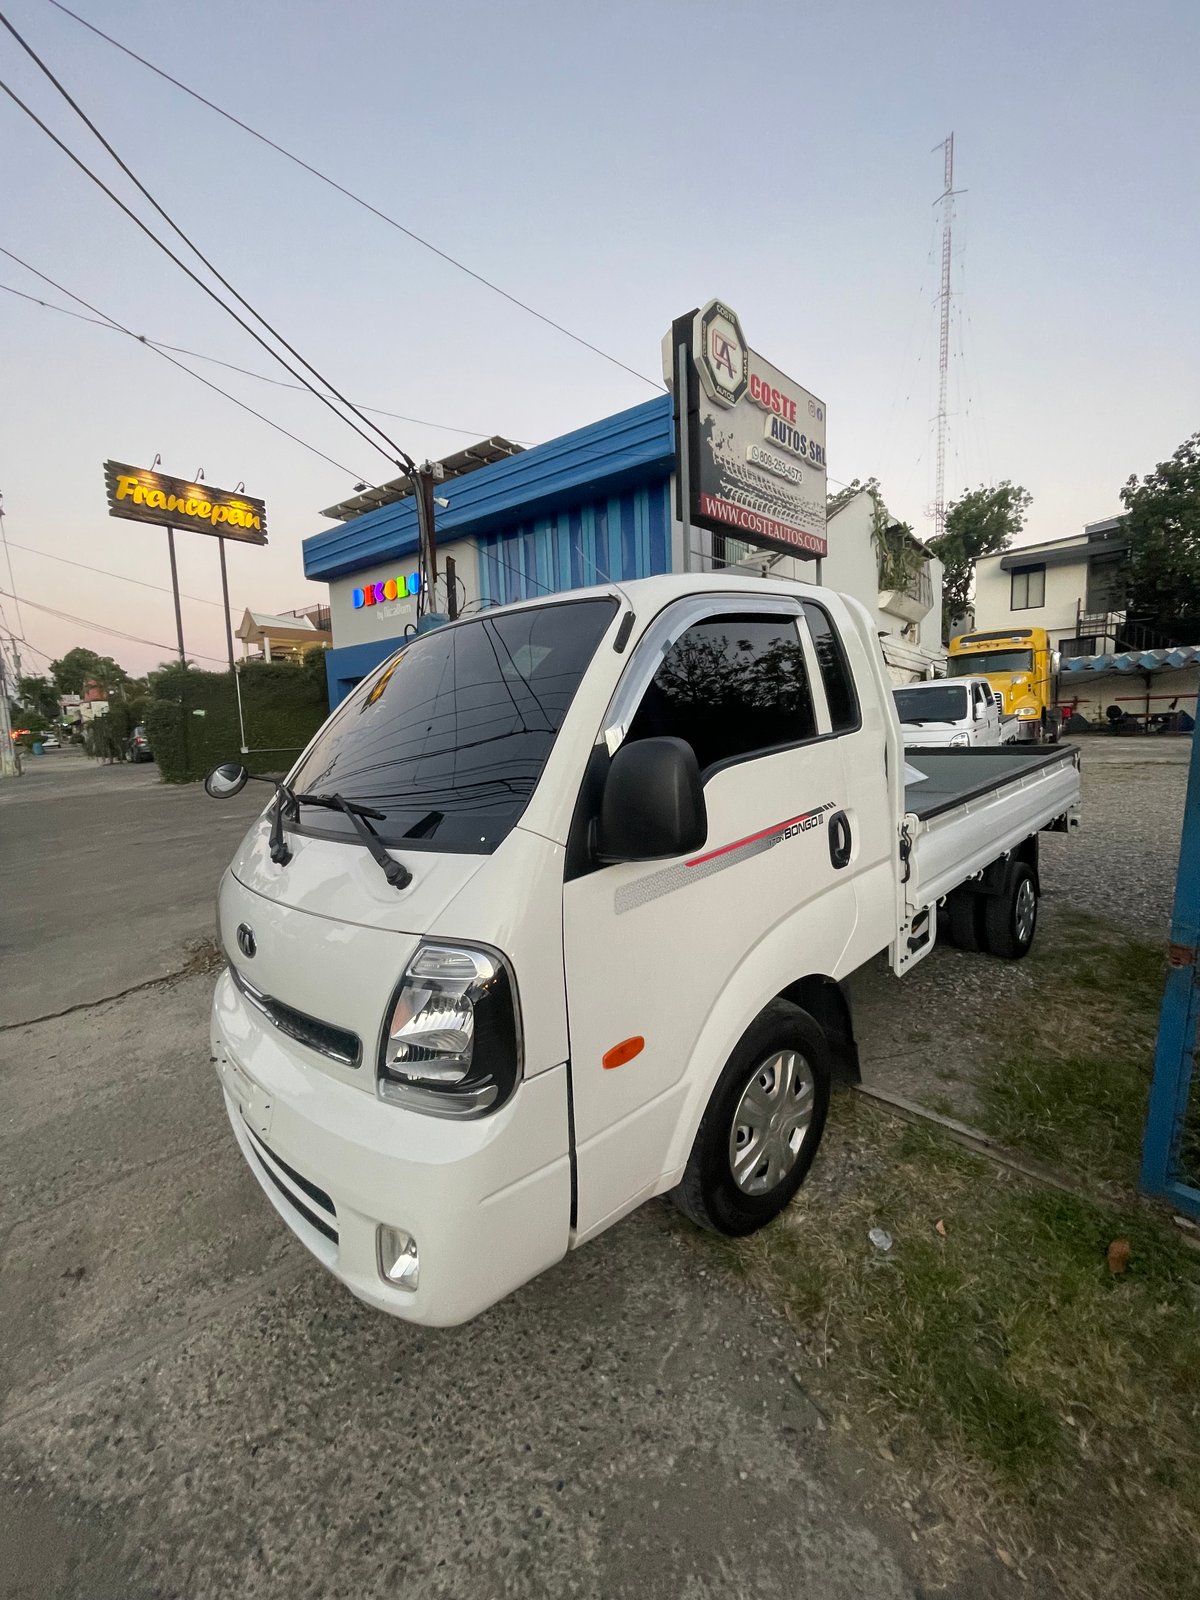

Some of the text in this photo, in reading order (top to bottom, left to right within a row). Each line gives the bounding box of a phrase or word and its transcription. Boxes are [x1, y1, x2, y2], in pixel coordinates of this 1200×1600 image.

[717, 304, 736, 323] COSTE
[717, 384, 735, 403] AUTOS
[750, 374, 797, 424] COSTE
[771, 416, 826, 466] AUTOS SRL
[116, 474, 261, 530] Francepan
[705, 498, 824, 554] WWW.COSTEAUTOS.COM
[784, 816, 818, 840] BONGO
